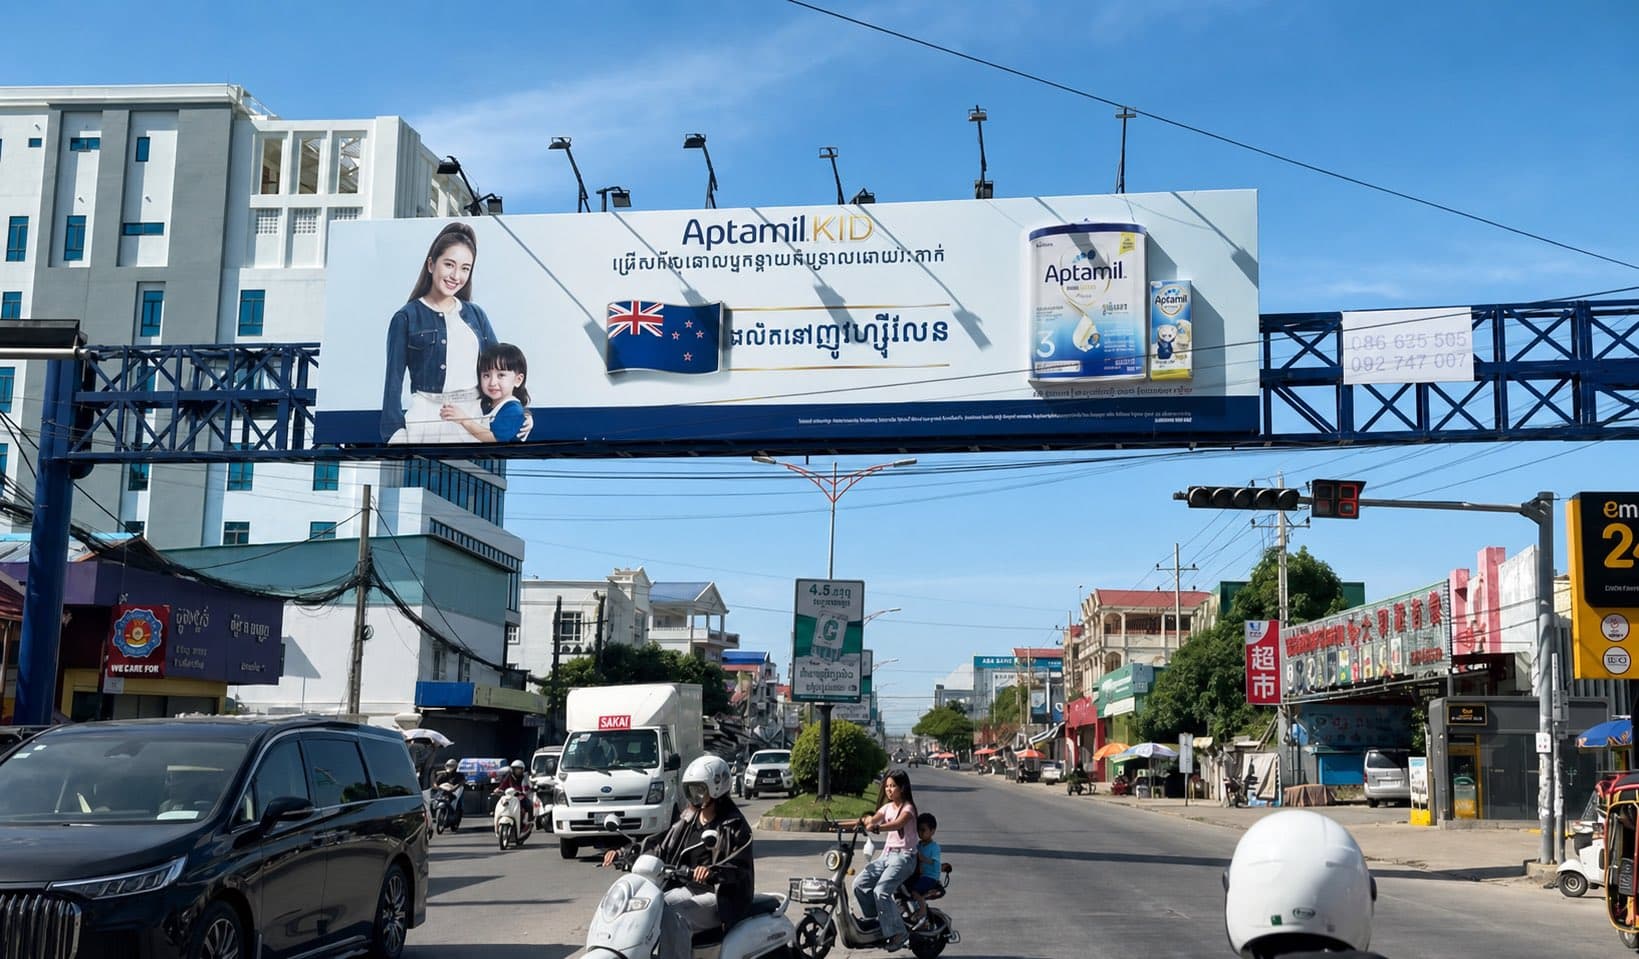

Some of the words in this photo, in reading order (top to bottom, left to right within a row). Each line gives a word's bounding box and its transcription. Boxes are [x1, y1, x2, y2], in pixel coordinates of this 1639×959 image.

[812, 215, 873, 242] KID
[1351, 356, 1385, 372] 092
[111, 664, 123, 673] WE
[124, 664, 143, 673] CARE
[144, 665, 159, 673] FOR
[1251, 645, 1276, 699] 超市
[600, 717, 629, 728] SAKAI
